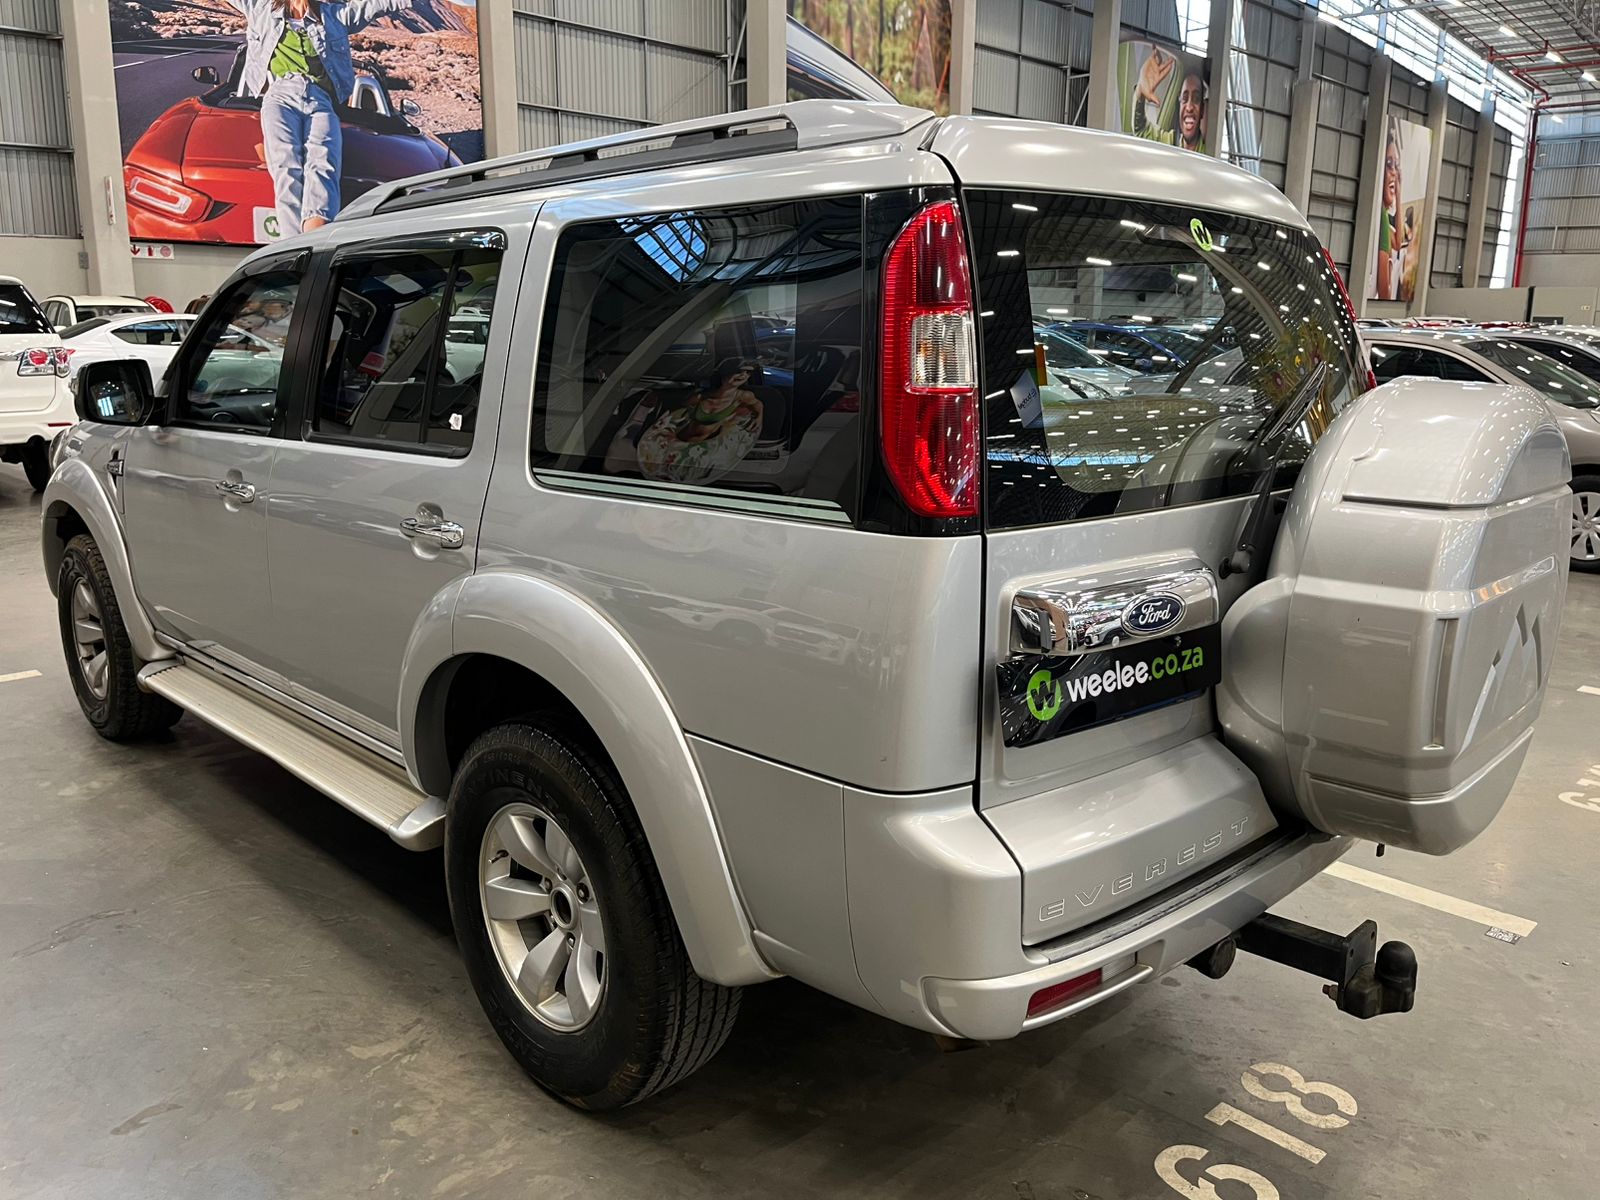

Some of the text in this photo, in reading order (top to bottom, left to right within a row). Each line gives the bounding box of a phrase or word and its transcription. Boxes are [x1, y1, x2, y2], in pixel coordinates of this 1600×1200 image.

[1139, 601, 1172, 625] Ford
[1066, 646, 1204, 703] weelee.co.za
[1039, 817, 1248, 922] EVEREST
[1154, 1062, 1358, 1200] 618
